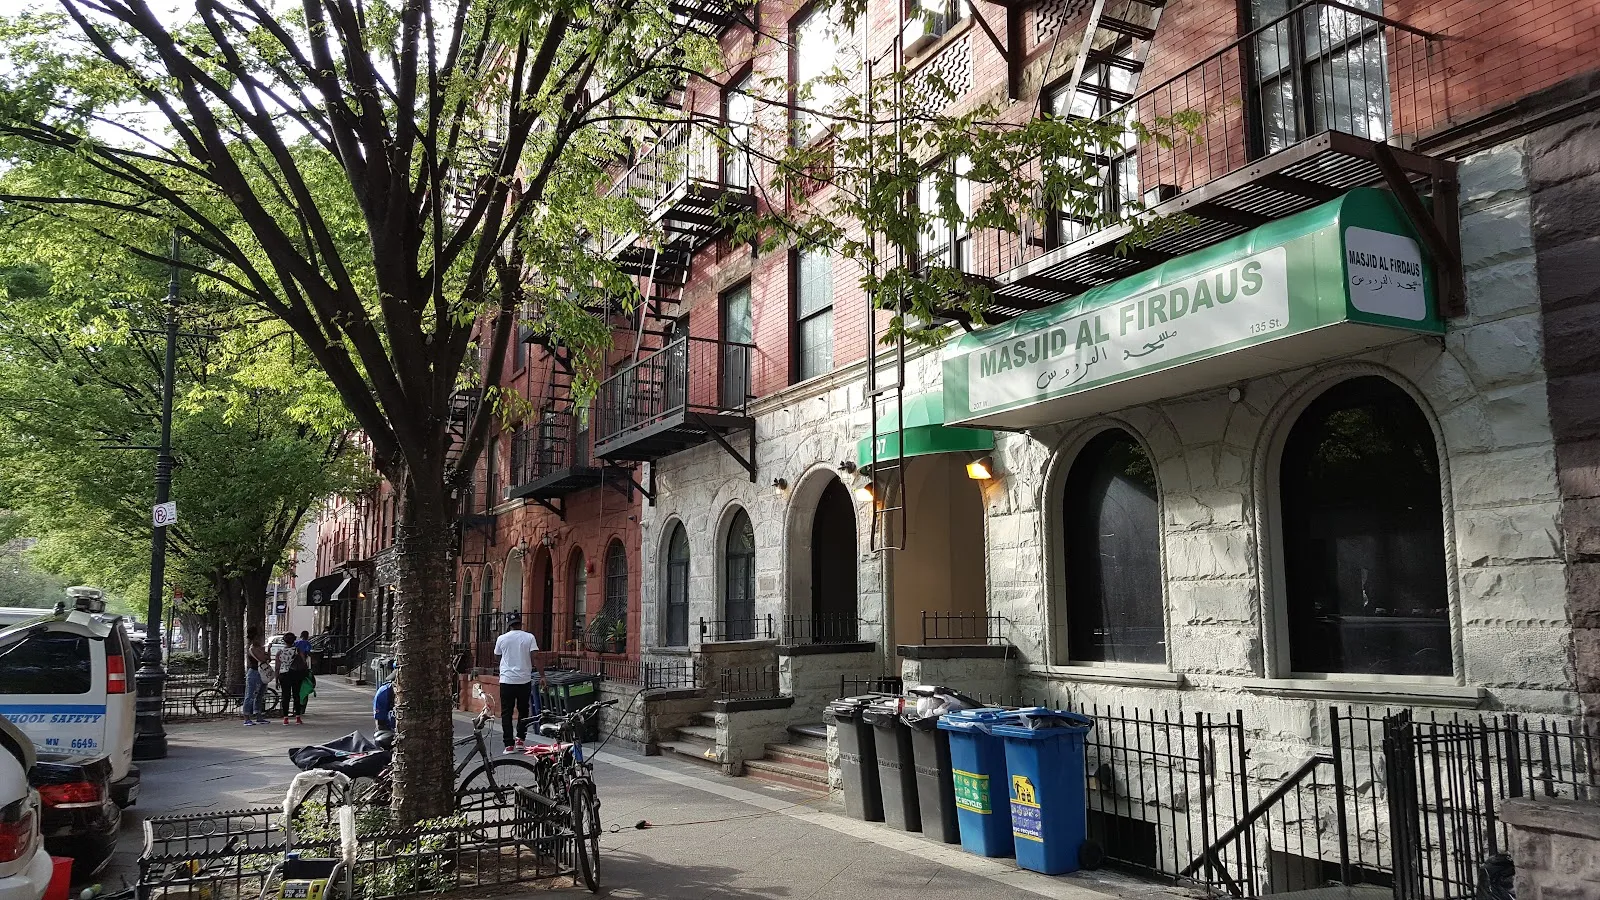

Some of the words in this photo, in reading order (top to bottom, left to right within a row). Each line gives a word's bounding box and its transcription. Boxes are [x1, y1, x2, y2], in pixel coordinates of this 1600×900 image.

[1349, 250, 1378, 269] MASJID
[1379, 256, 1389, 271] AL
[1390, 258, 1420, 277] FIRDAUS
[980, 328, 1067, 378] MASJID
[1075, 315, 1110, 351] AL
[1119, 260, 1263, 336] FIRDAUS
[1250, 321, 1266, 334] 135
[1268, 318, 1282, 330] St.
[50, 714, 102, 724] SAFETY
[45, 738, 60, 746] MN
[71, 738, 93, 748] 6649
[1020, 828, 1038, 837] recycles
